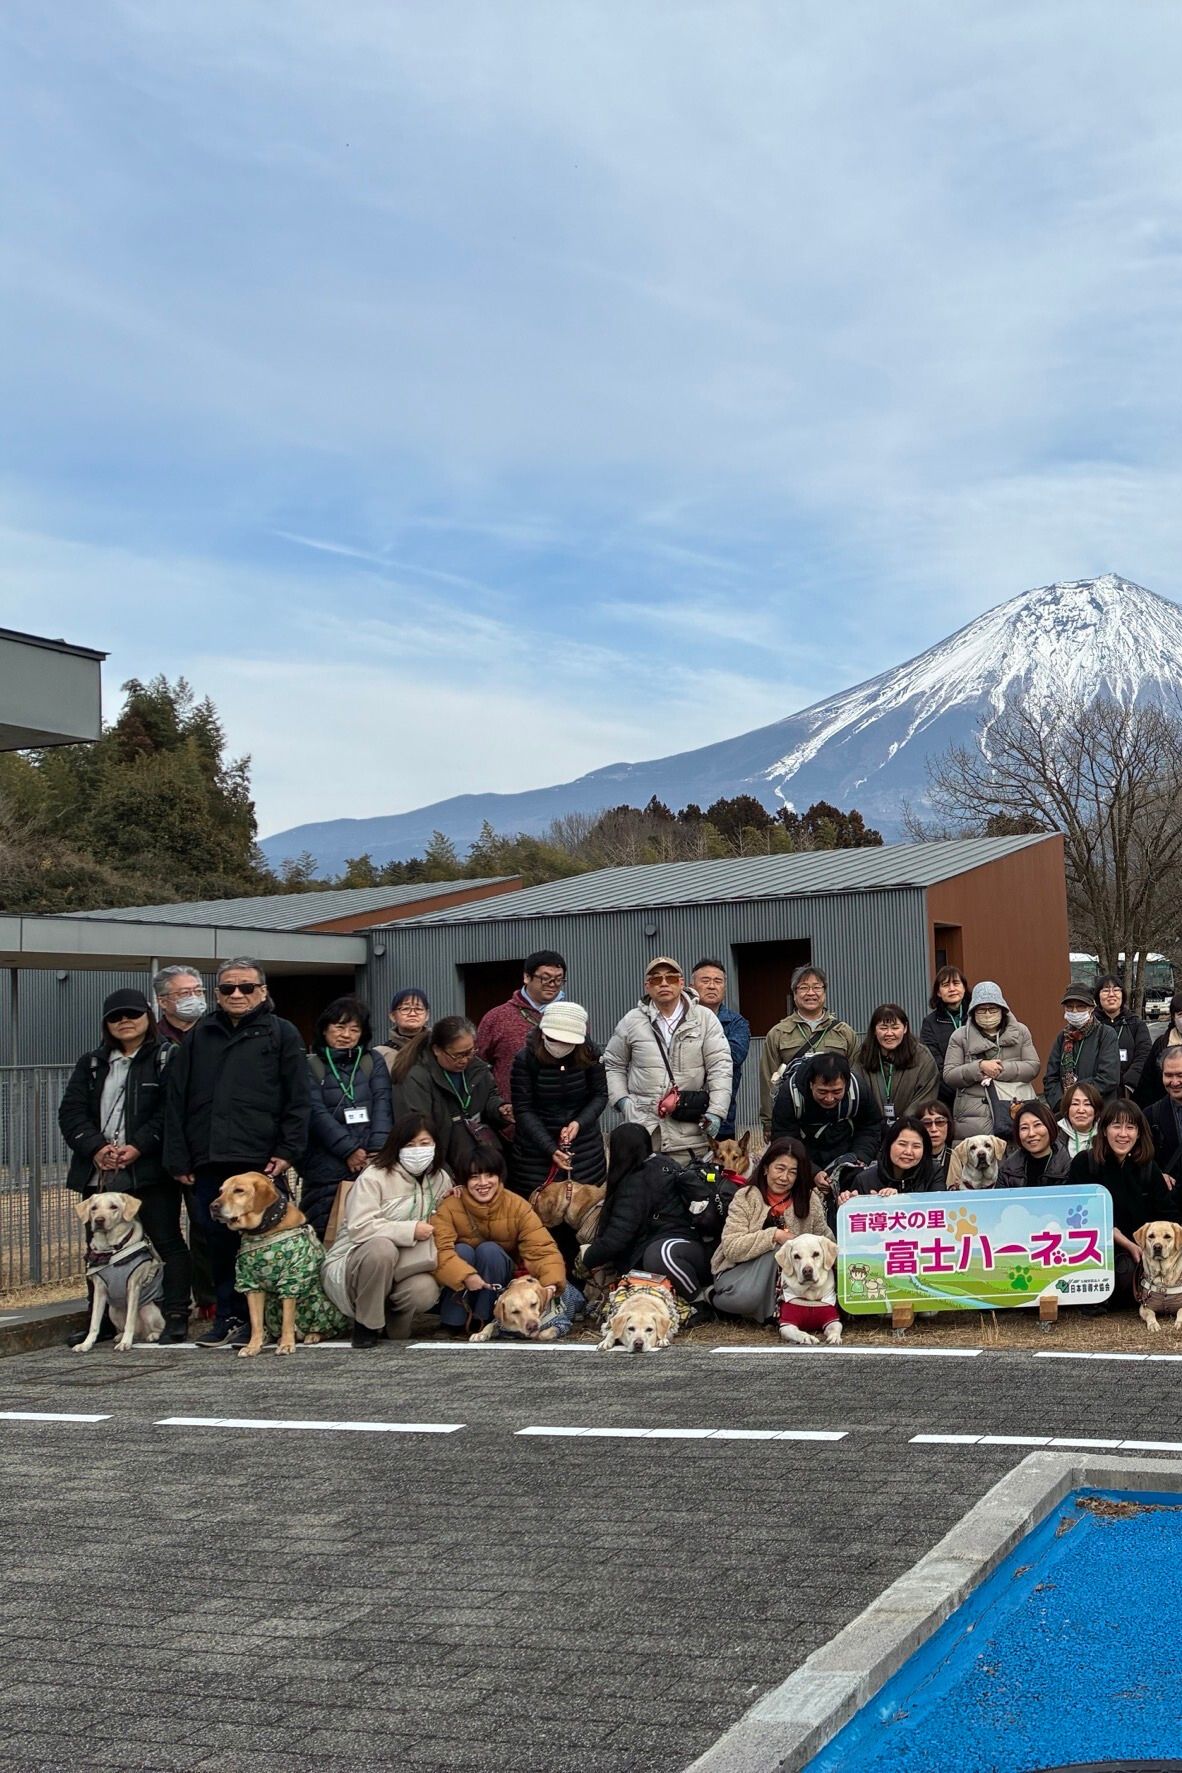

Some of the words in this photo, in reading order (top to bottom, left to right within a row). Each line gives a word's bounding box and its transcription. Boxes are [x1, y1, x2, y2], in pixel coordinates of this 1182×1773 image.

[848, 1210, 946, 1233] 盲導犬の里
[885, 1229, 1102, 1275] 富士ハーネス
